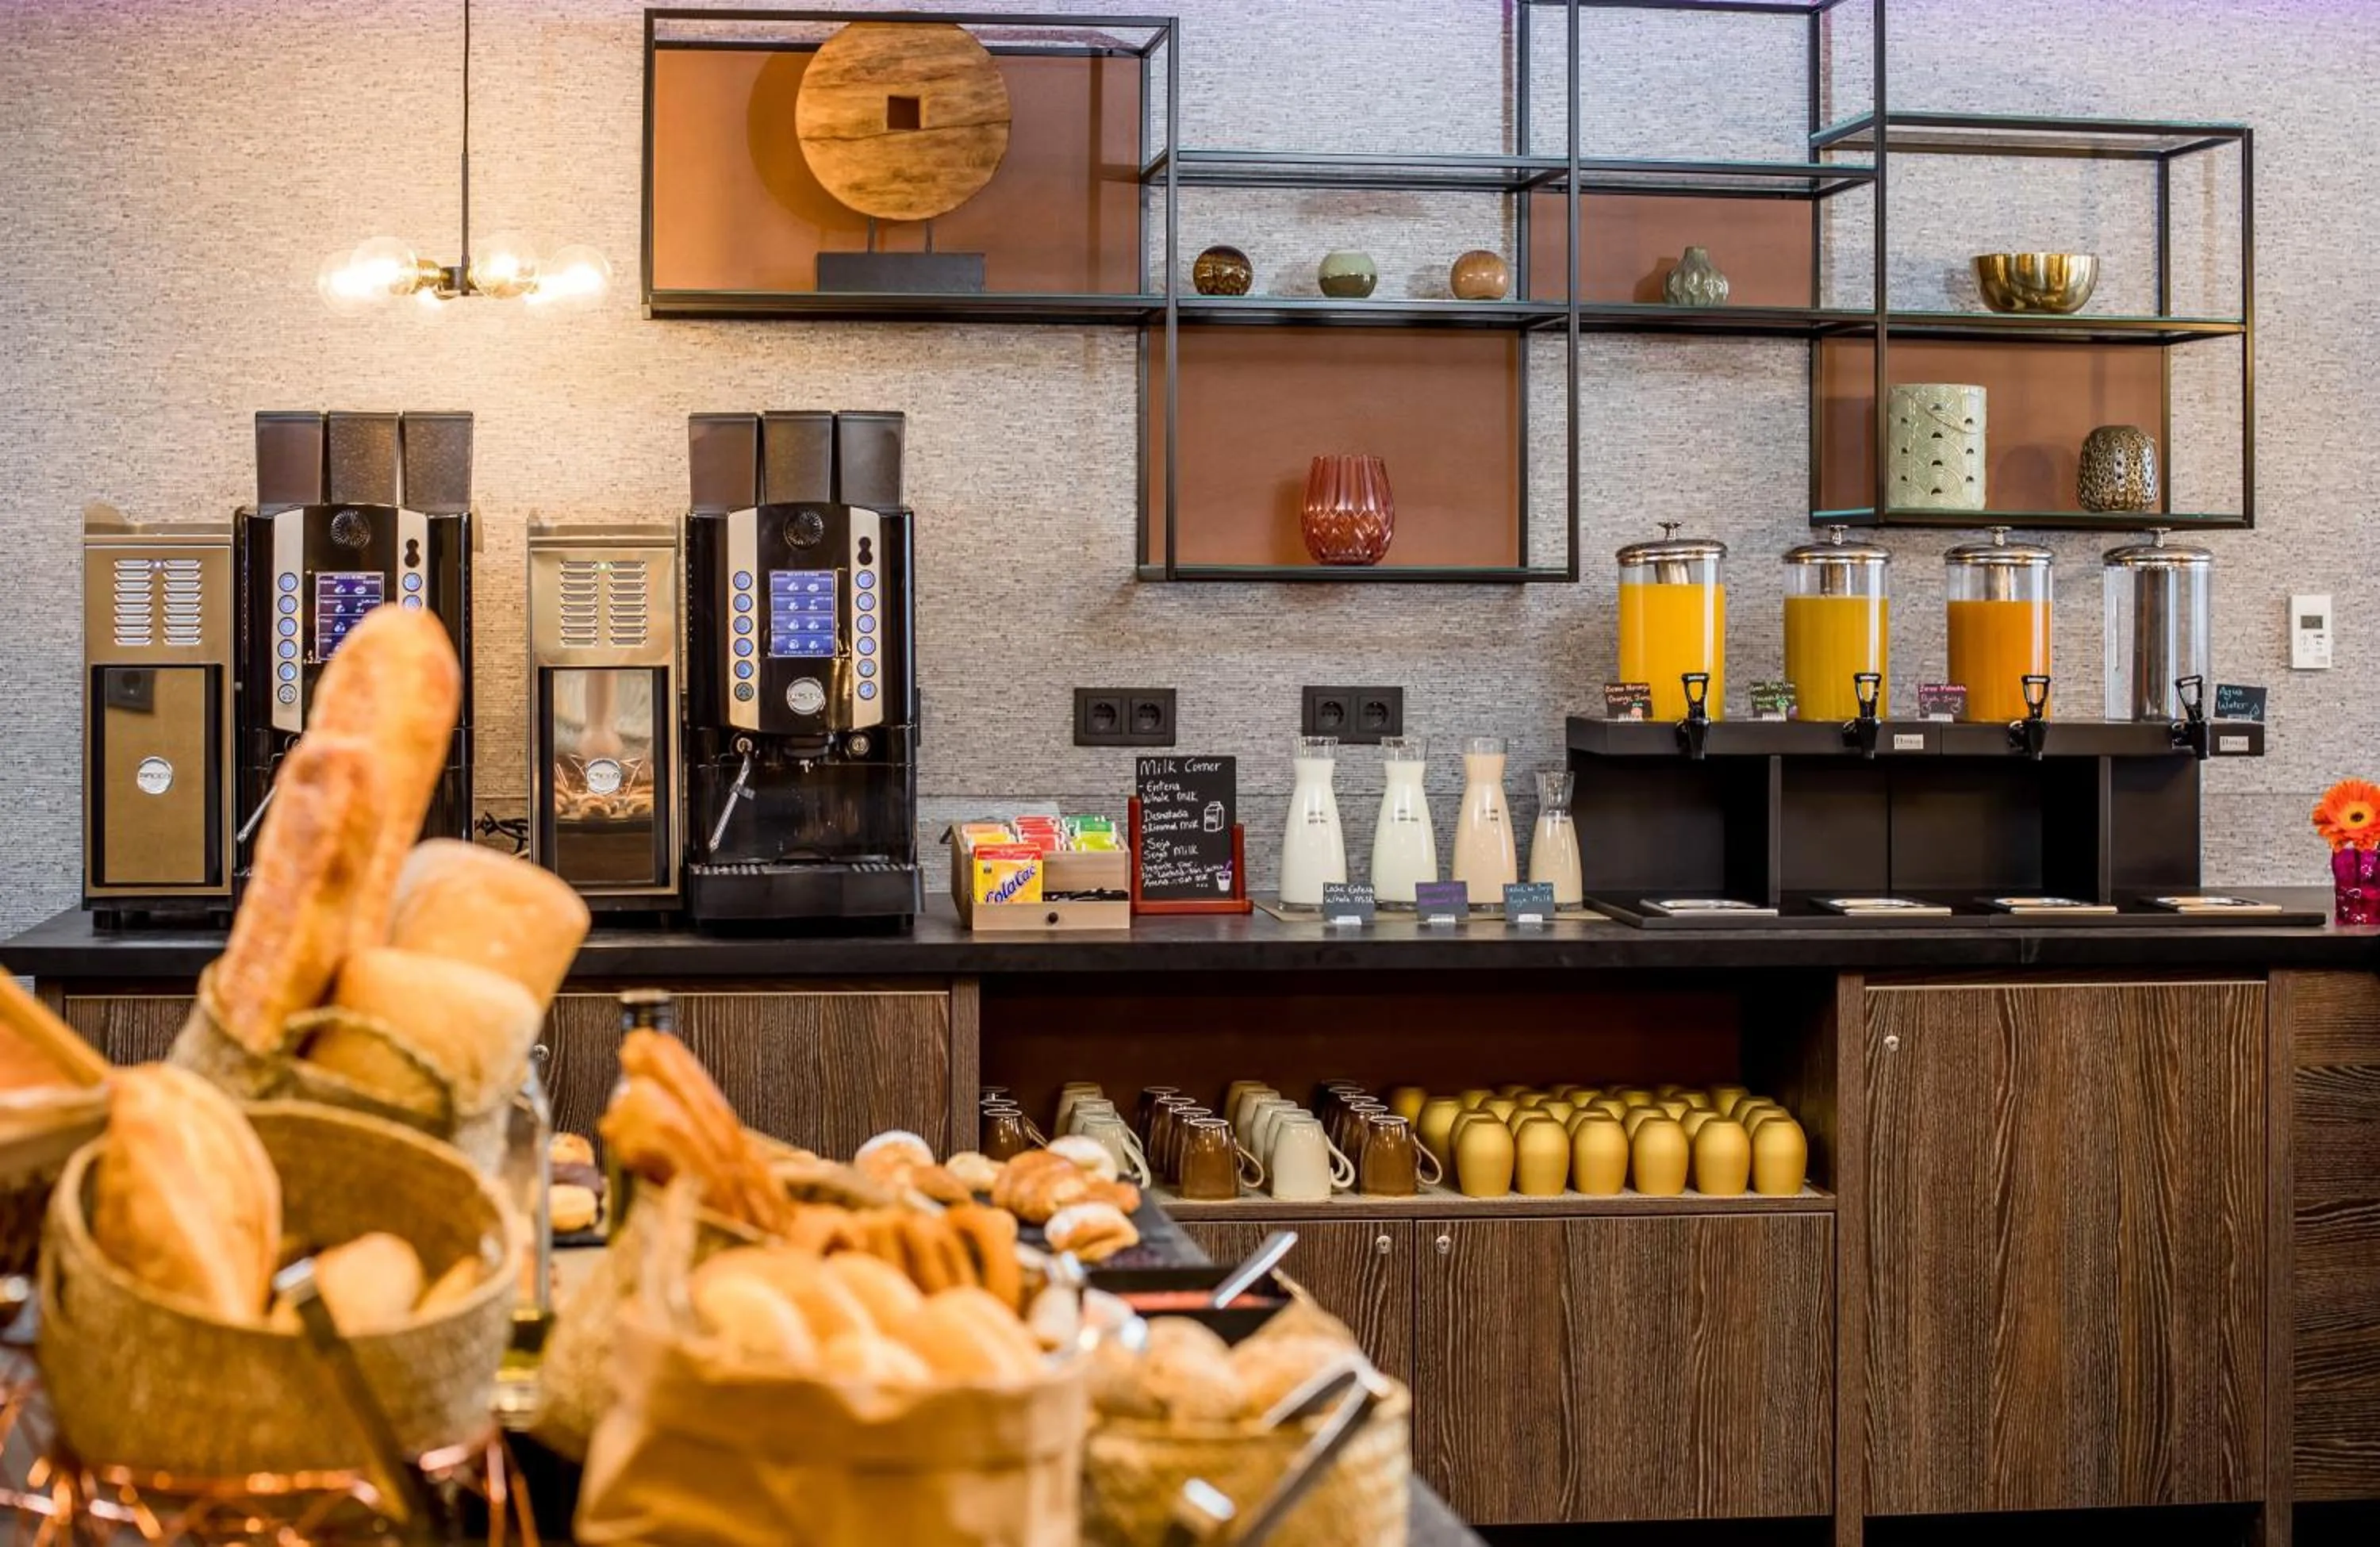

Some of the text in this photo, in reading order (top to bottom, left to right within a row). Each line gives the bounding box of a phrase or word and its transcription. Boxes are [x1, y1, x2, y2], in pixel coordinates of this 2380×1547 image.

[2217, 701, 2248, 711] Water
[1140, 758, 1222, 776] Milk Corner
[1146, 780, 1180, 793] Entera
